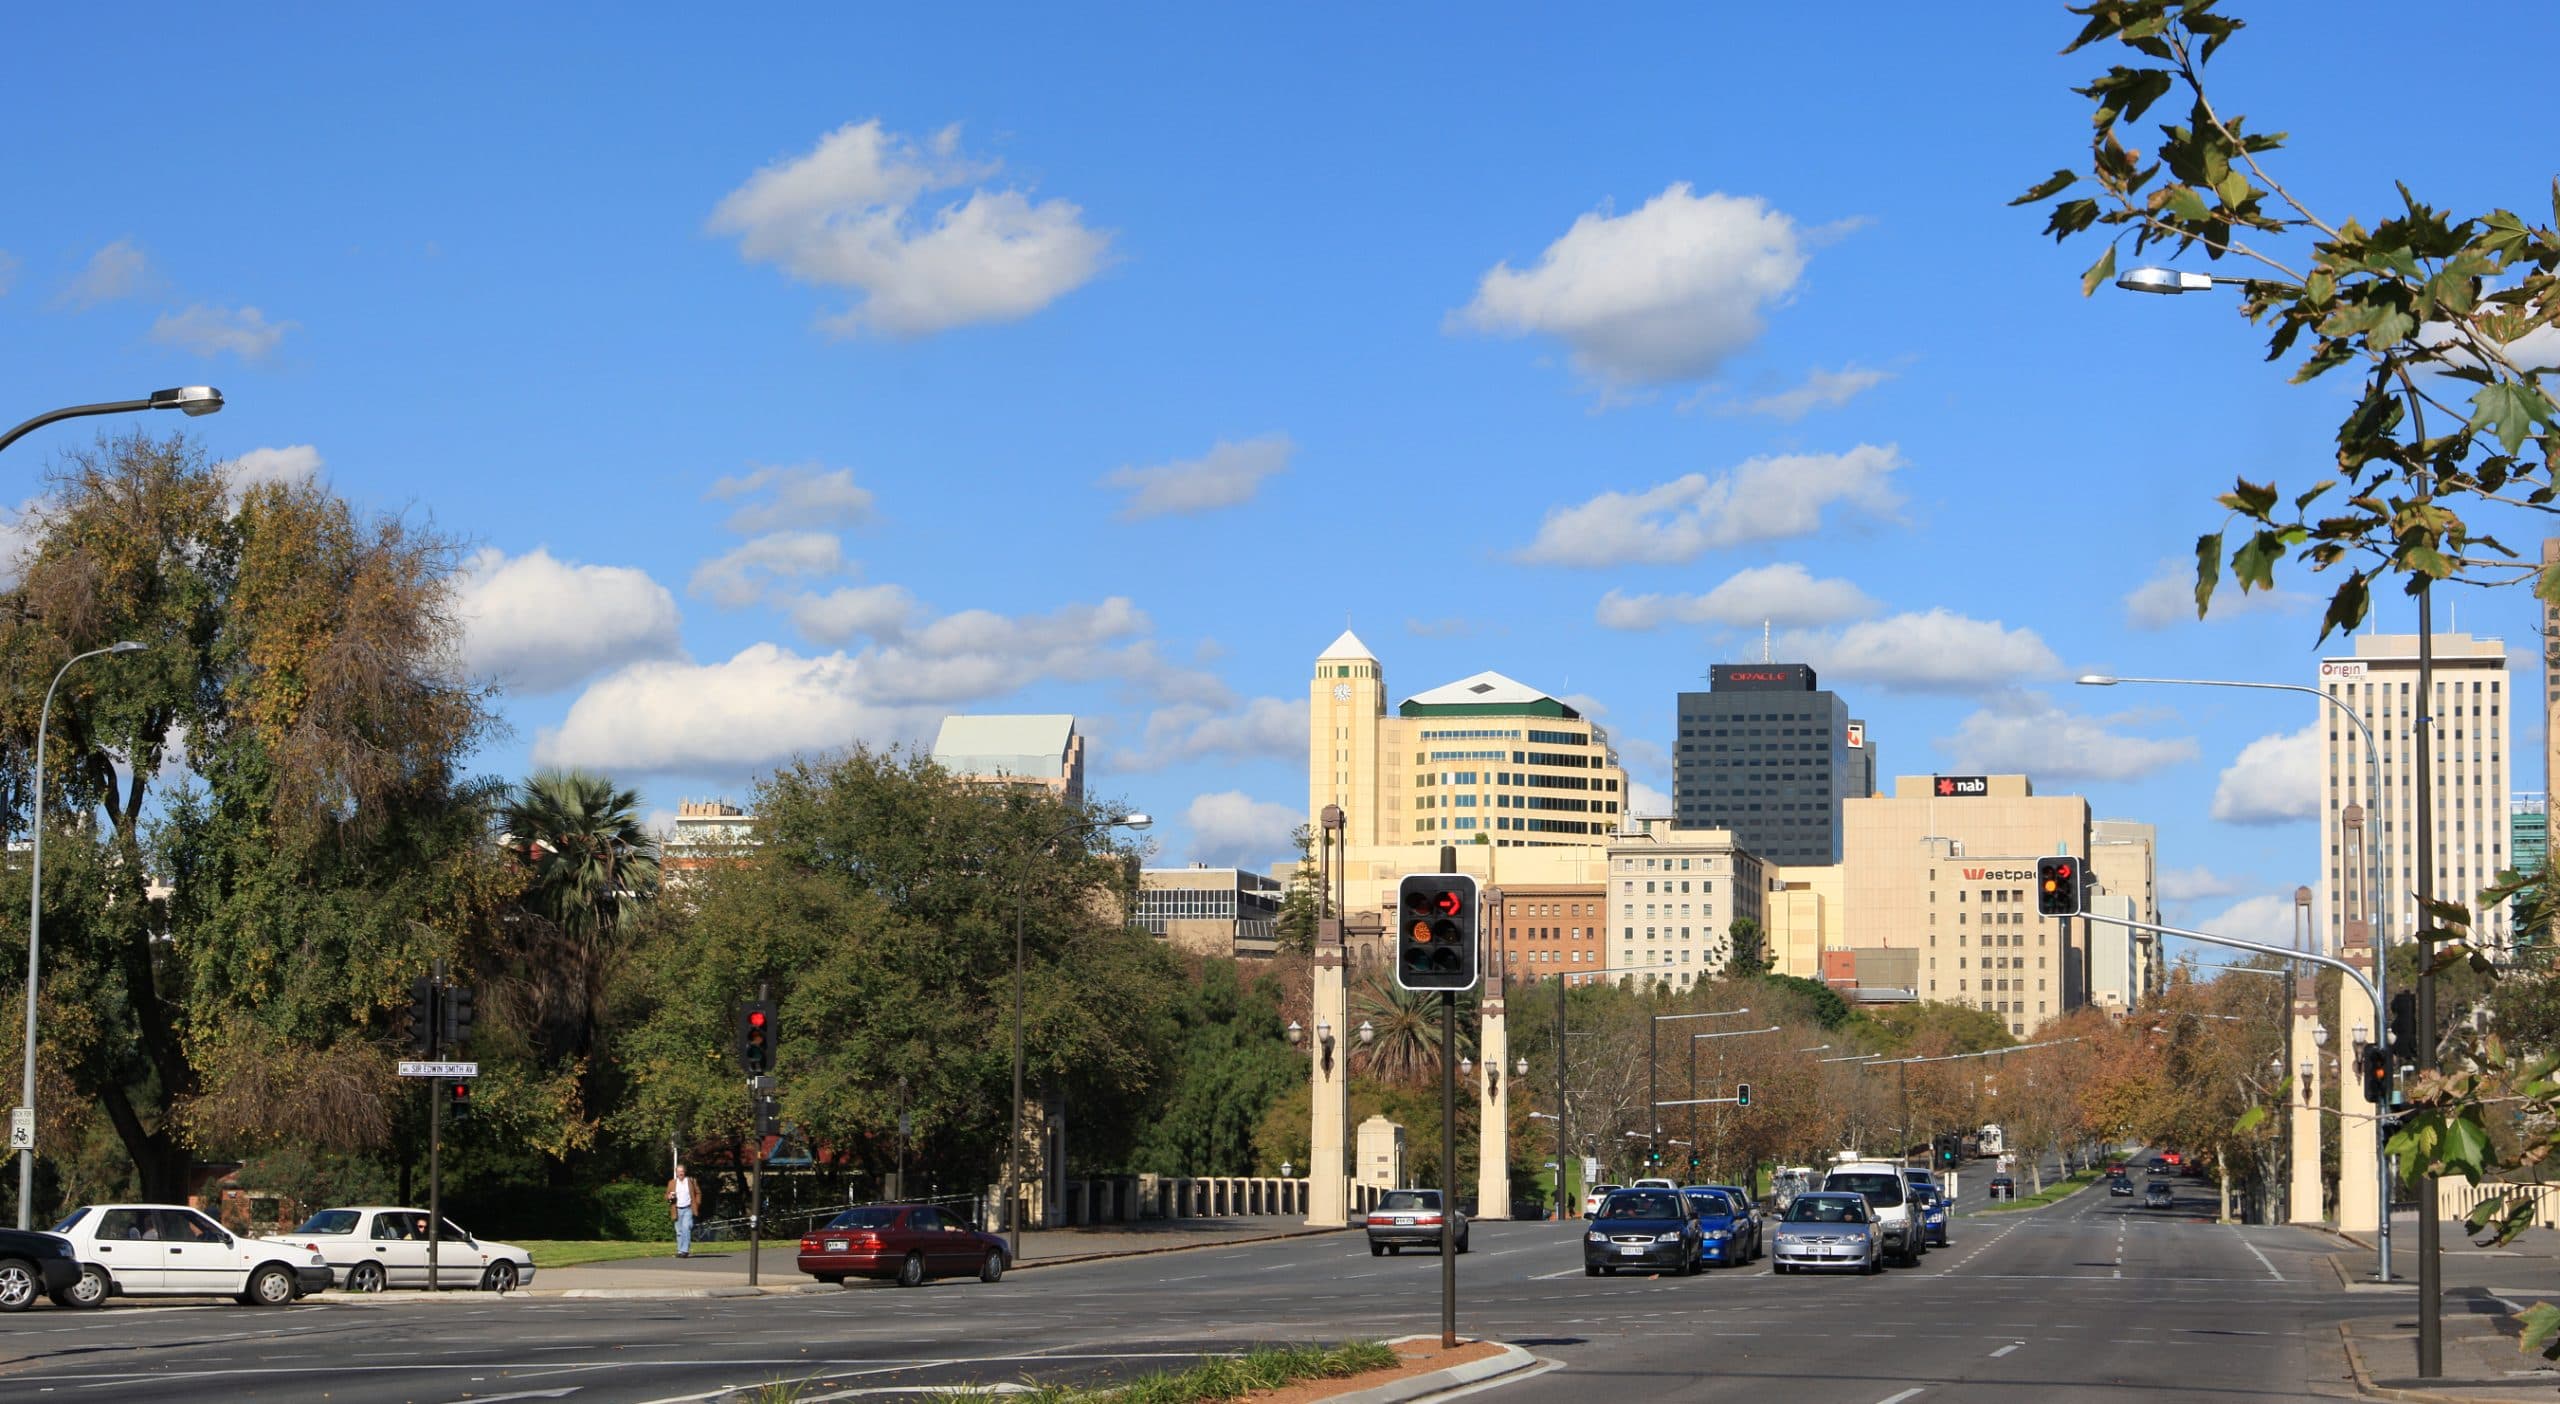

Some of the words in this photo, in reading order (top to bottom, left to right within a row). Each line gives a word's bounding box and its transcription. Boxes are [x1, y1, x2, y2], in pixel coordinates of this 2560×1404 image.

[2322, 664, 2361, 677] Origin
[1730, 672, 1786, 681] ORACLE
[1957, 779, 1985, 791] nab
[411, 1063, 422, 1073] SIR
[424, 1064, 443, 1073] EDWIN
[444, 1064, 464, 1073] SMITH
[465, 1065, 474, 1073] AV
